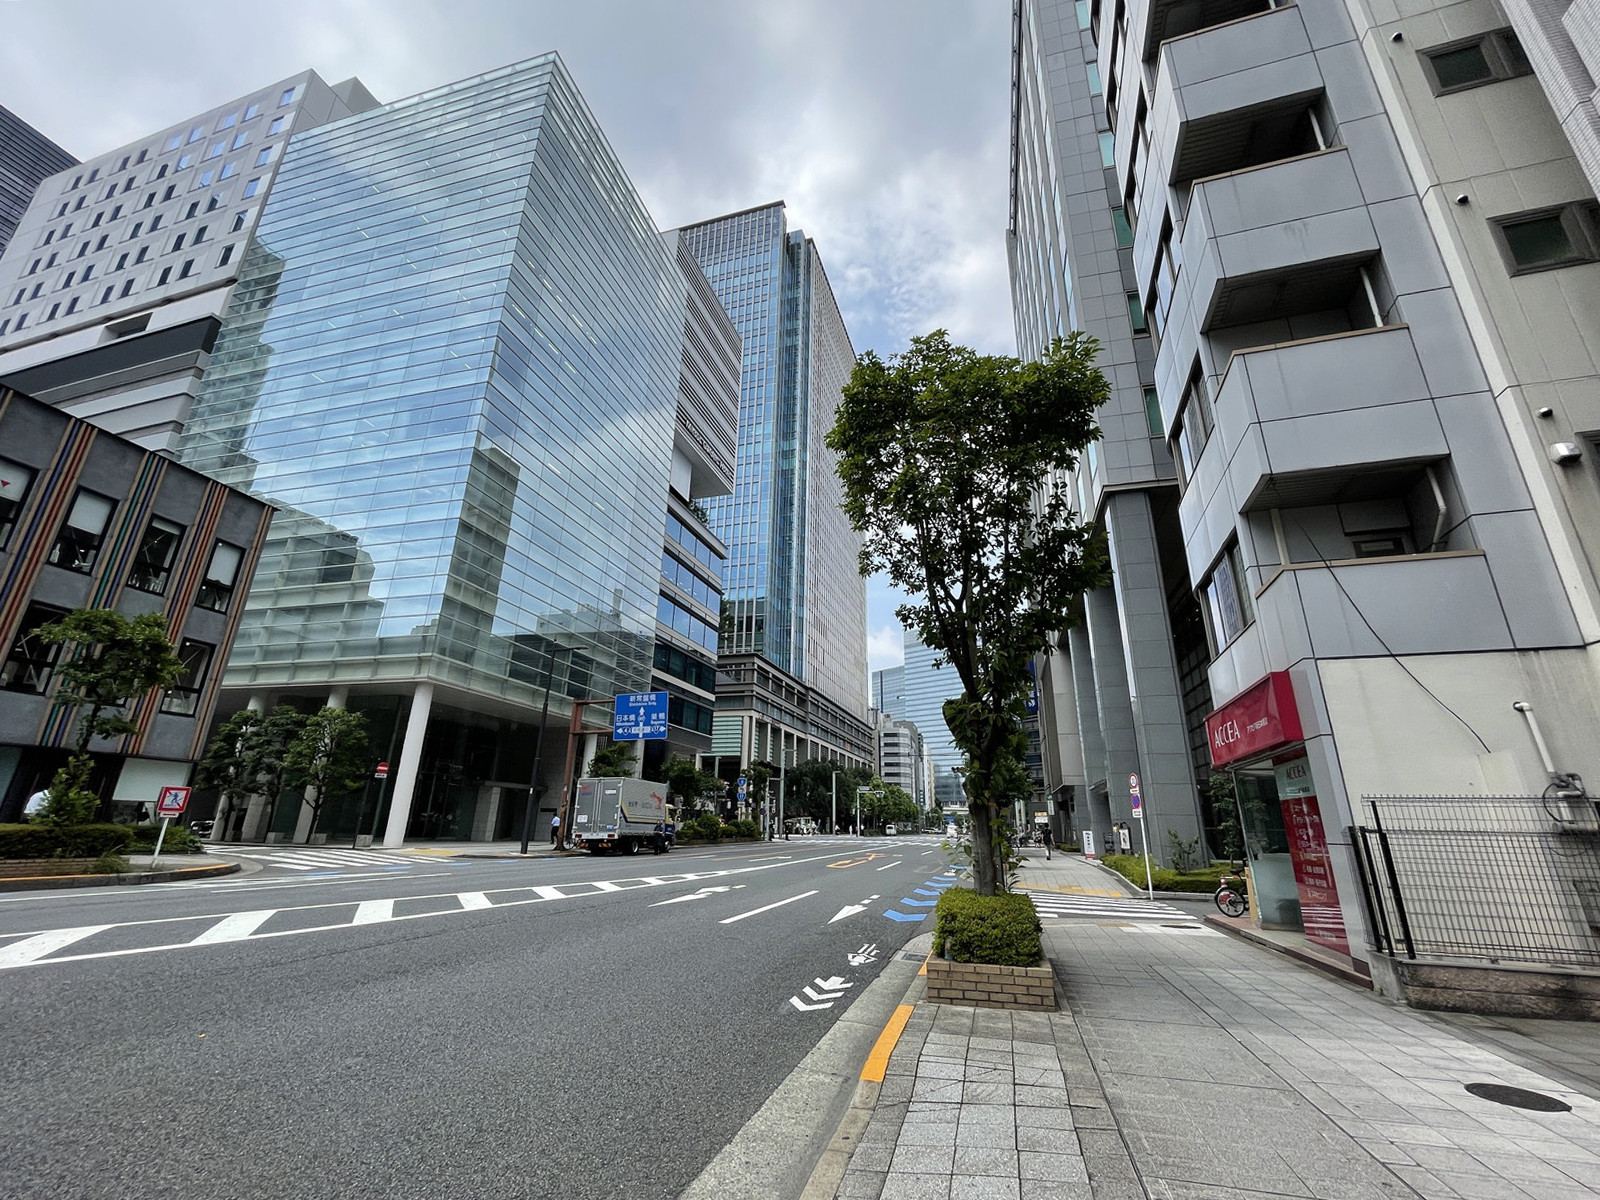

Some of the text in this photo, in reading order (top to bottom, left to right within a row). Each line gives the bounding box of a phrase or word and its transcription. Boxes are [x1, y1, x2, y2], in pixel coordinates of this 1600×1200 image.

[616, 714, 636, 722] 日本橋
[1214, 720, 1240, 749] ACCEA
[1285, 765, 1307, 780] ACCEA
